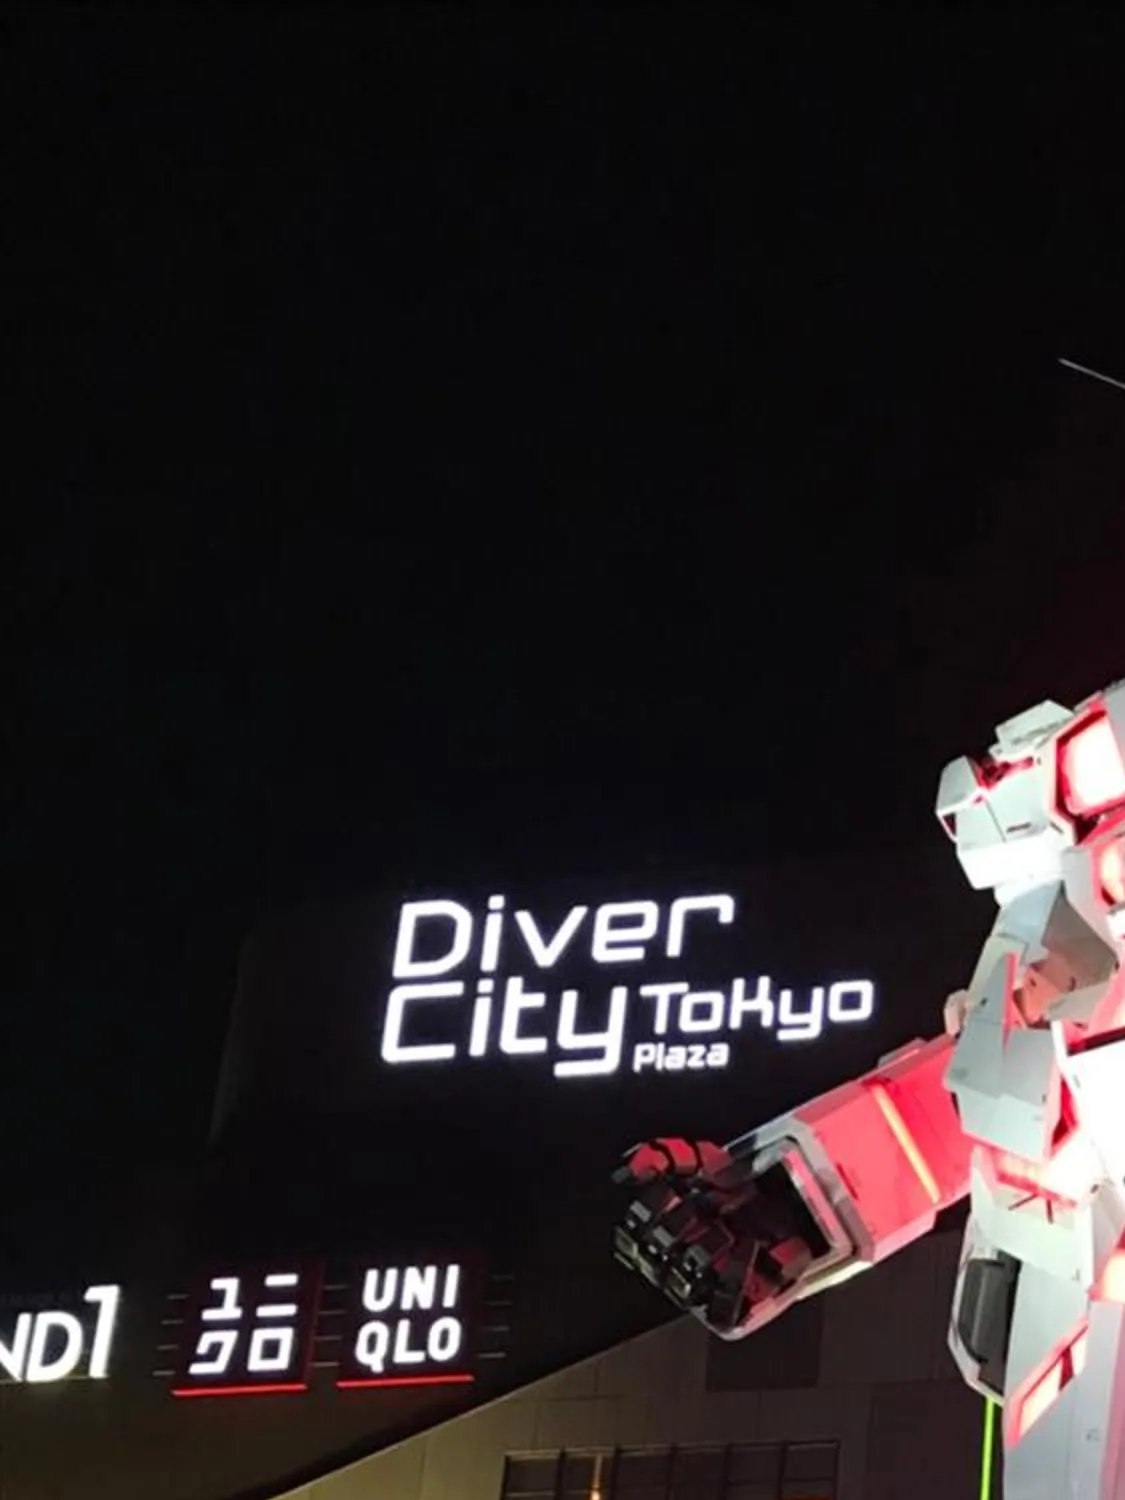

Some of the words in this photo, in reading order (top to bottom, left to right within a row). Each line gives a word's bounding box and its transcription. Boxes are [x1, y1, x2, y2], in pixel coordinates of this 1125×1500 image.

[392, 894, 735, 979] Diver
[380, 975, 628, 1078] City
[639, 975, 874, 1042] Tokyo
[632, 1042, 730, 1073] Plaza
[201, 1273, 299, 1321] ユニ
[362, 1264, 460, 1313] UNI
[188, 1326, 294, 1375] クロ
[354, 1316, 462, 1373] QLO
